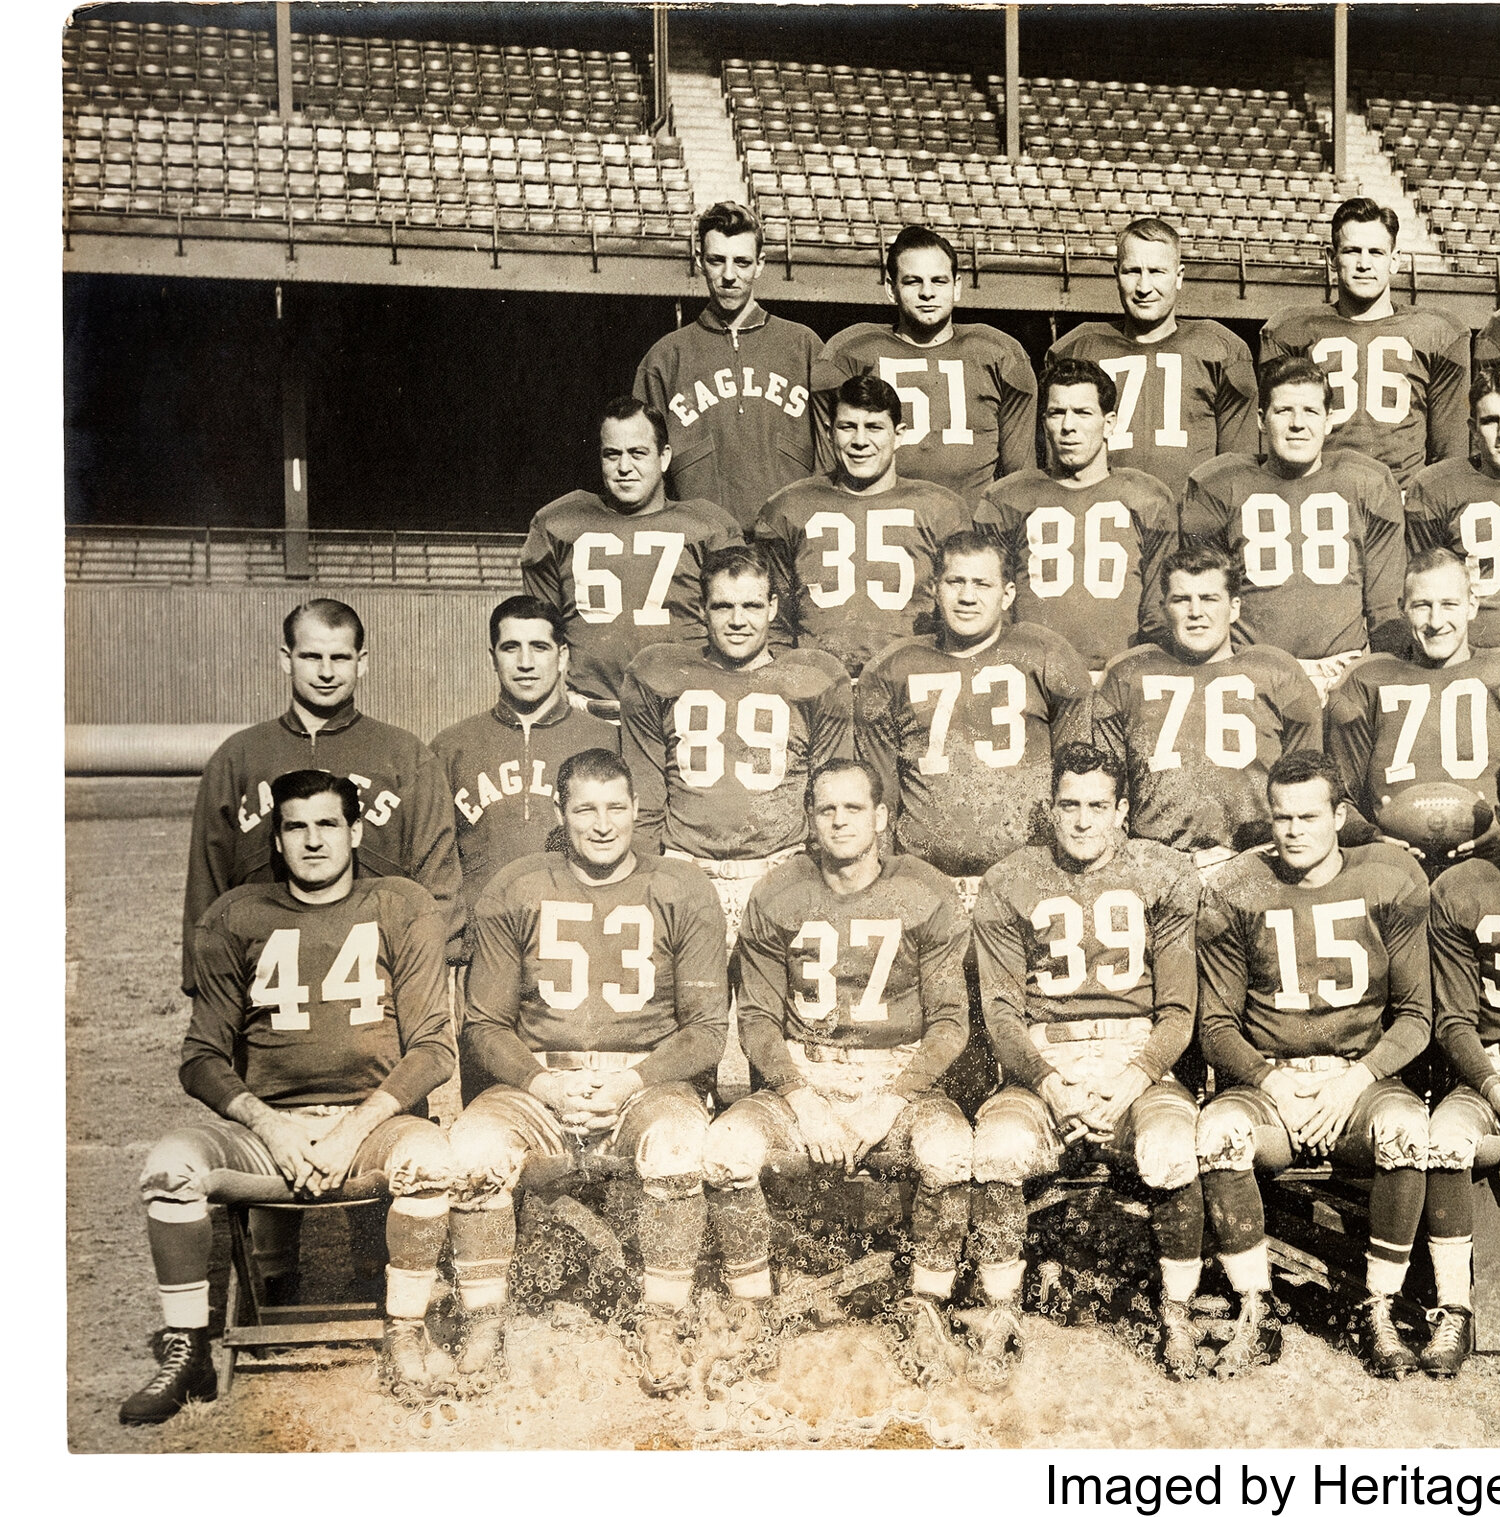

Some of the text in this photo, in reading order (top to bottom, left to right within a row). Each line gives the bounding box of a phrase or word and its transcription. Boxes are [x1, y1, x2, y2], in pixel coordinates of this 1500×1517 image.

[669, 367, 810, 427] EAGLES
[879, 357, 974, 446] 51
[1100, 353, 1188, 450] 71
[1312, 336, 1413, 425] 36
[572, 530, 685, 626] 67
[805, 509, 915, 611] 35
[1026, 501, 1131, 600] 86
[1242, 491, 1349, 587] 88
[674, 689, 790, 791] 89
[908, 665, 1027, 775] 73
[1143, 674, 1257, 772] 76
[1379, 677, 1489, 783] 70
[454, 759, 559, 825] EAGL
[250, 921, 386, 1031] 44
[537, 899, 656, 1013] 53
[790, 918, 902, 1022] 37
[1032, 888, 1147, 997] 39
[1263, 898, 1370, 1010] 15
